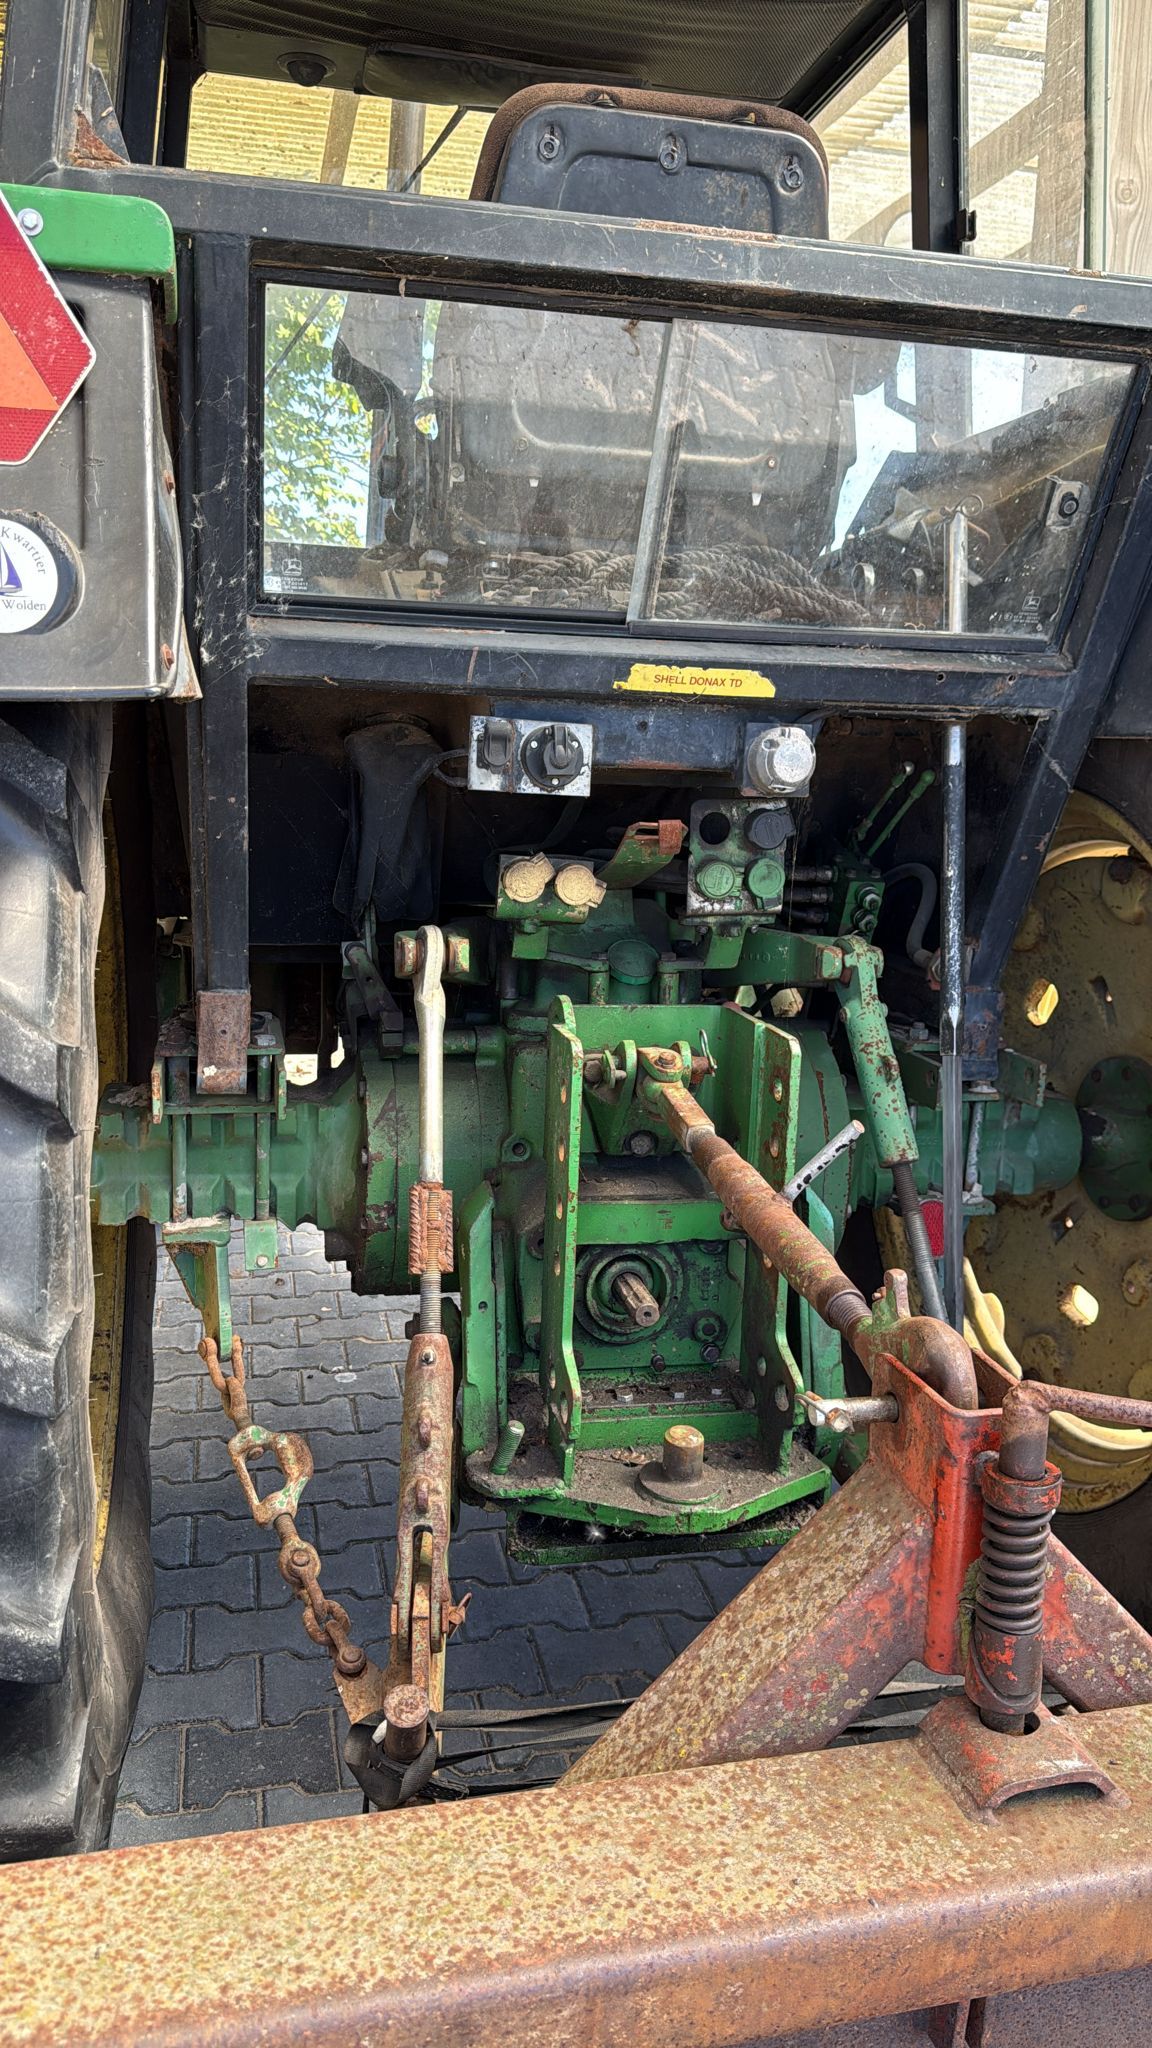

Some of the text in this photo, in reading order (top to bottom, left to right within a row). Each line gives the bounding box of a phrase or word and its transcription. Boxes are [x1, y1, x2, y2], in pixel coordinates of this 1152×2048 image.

[1, 526, 46, 575] Kwartier
[2, 599, 47, 611] Wolden
[654, 674, 743, 688] SHELL DONAX TD
